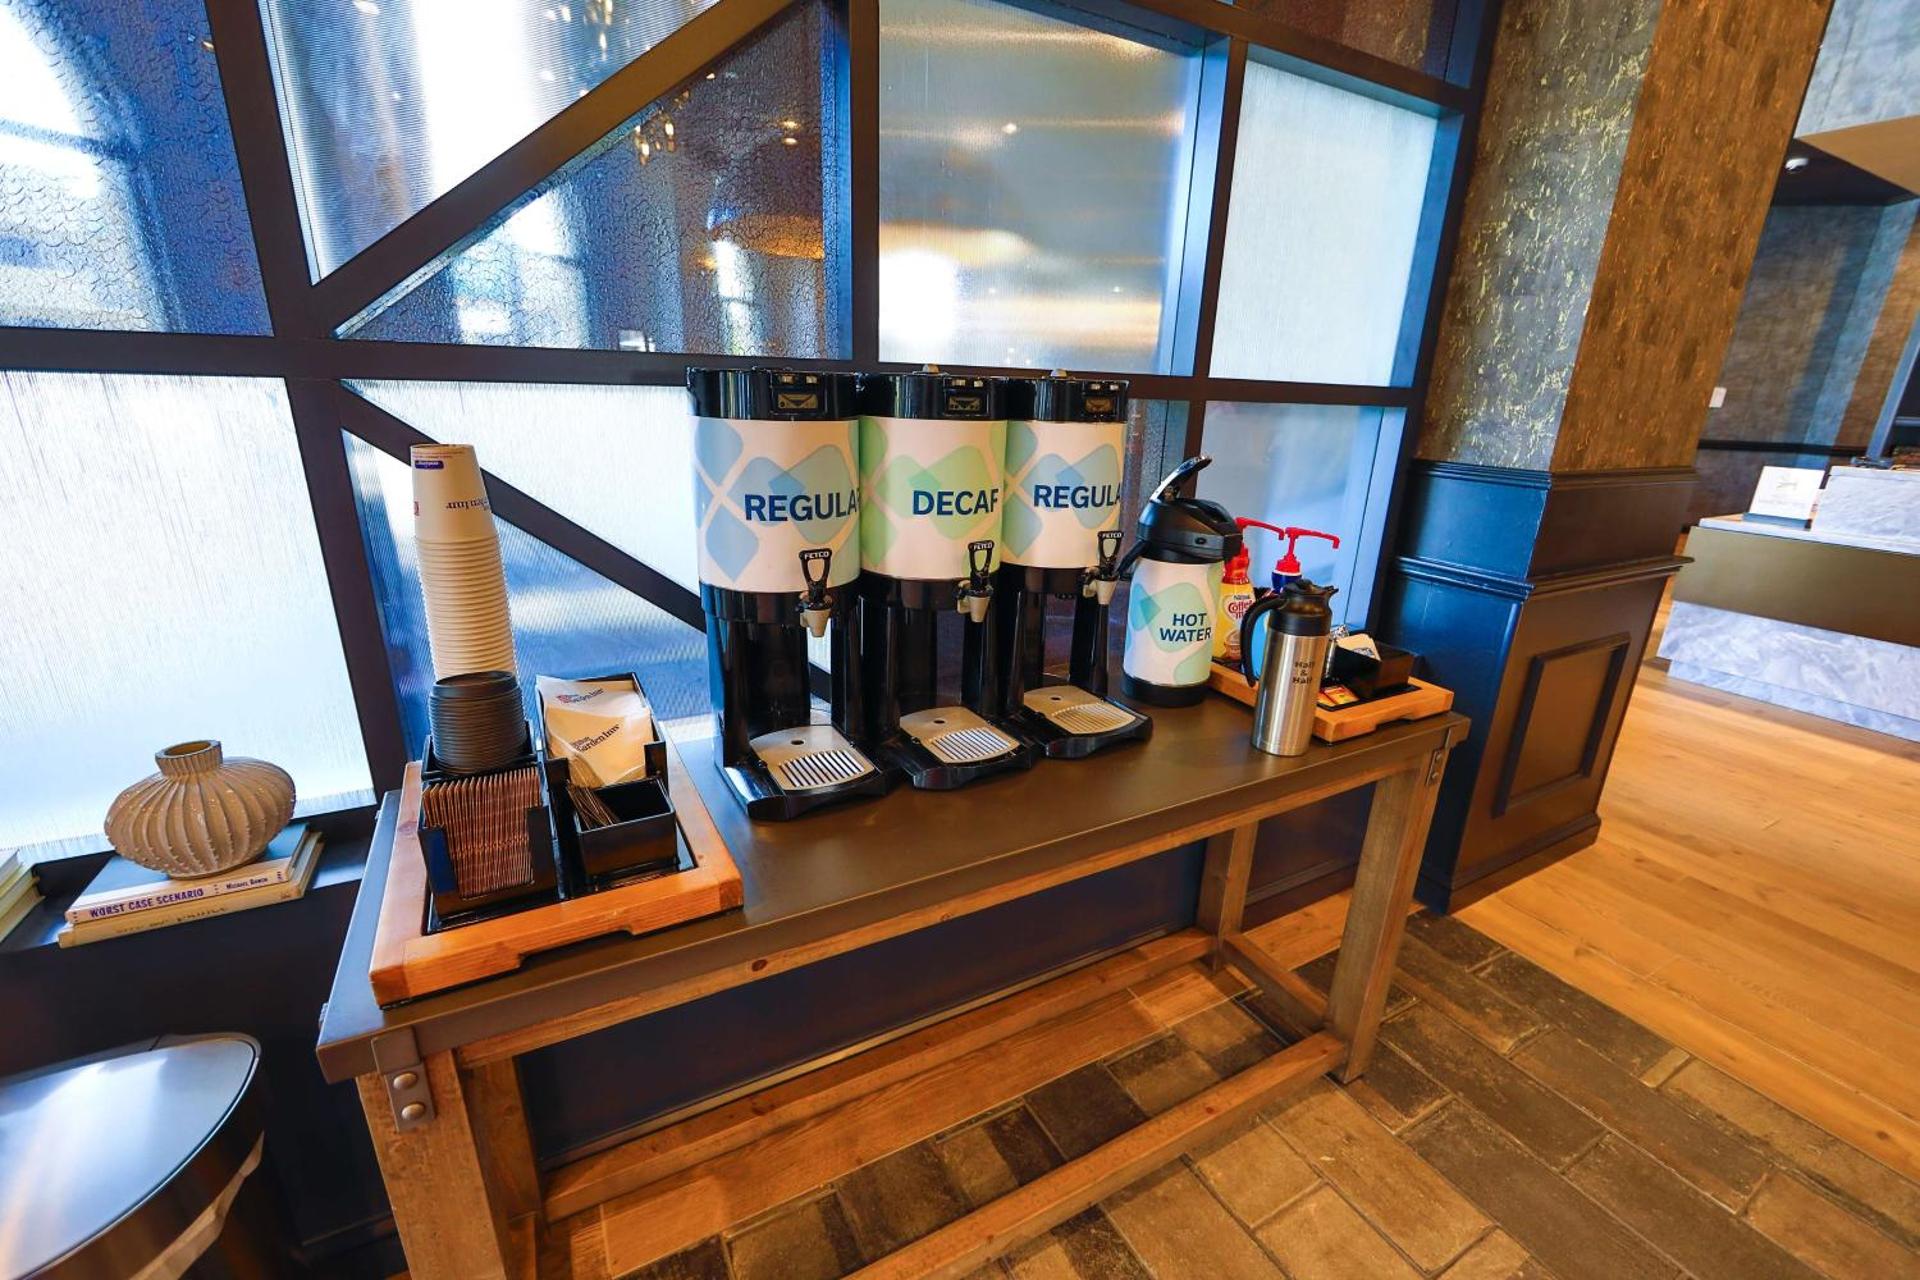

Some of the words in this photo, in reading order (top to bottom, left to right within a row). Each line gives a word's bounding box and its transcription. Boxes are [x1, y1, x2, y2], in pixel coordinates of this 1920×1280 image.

[744, 488, 860, 521] REGULA
[912, 488, 999, 516] DECAF
[804, 551, 830, 560] FETCO
[1172, 612, 1208, 627] HOT
[1159, 626, 1212, 642] WATER
[89, 903, 126, 918] WORST
[128, 898, 154, 912] CASE
[155, 888, 205, 905] SCENARIO
